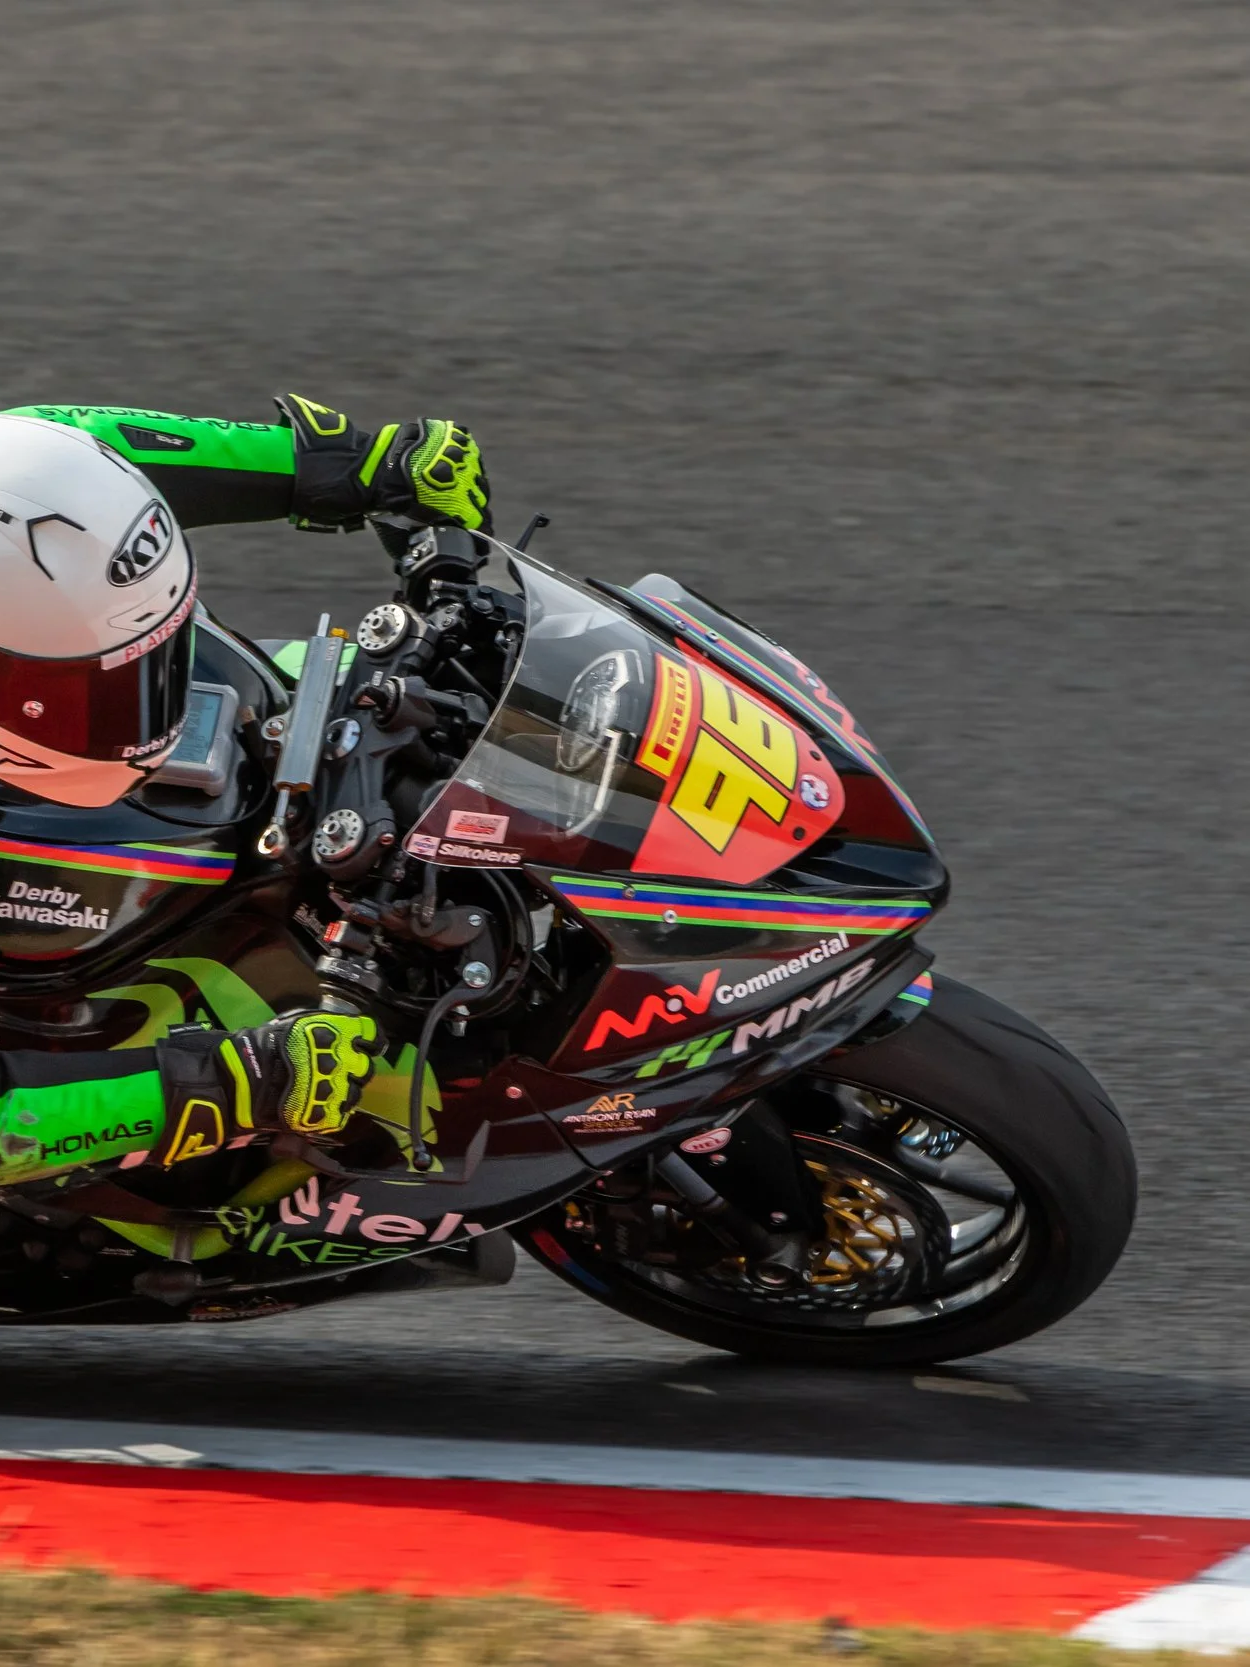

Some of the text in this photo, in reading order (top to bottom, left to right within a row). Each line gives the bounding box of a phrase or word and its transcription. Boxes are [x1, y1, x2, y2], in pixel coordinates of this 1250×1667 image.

[111, 503, 171, 584] KYT
[669, 666, 798, 855] 96
[438, 843, 522, 864] Silkolene
[7, 880, 82, 909] Derby
[716, 930, 850, 1005] Commercial
[731, 957, 877, 1055] MMB
[36, 1119, 155, 1160] HOMAS
[562, 1107, 657, 1123] ANTHONY RYAN
